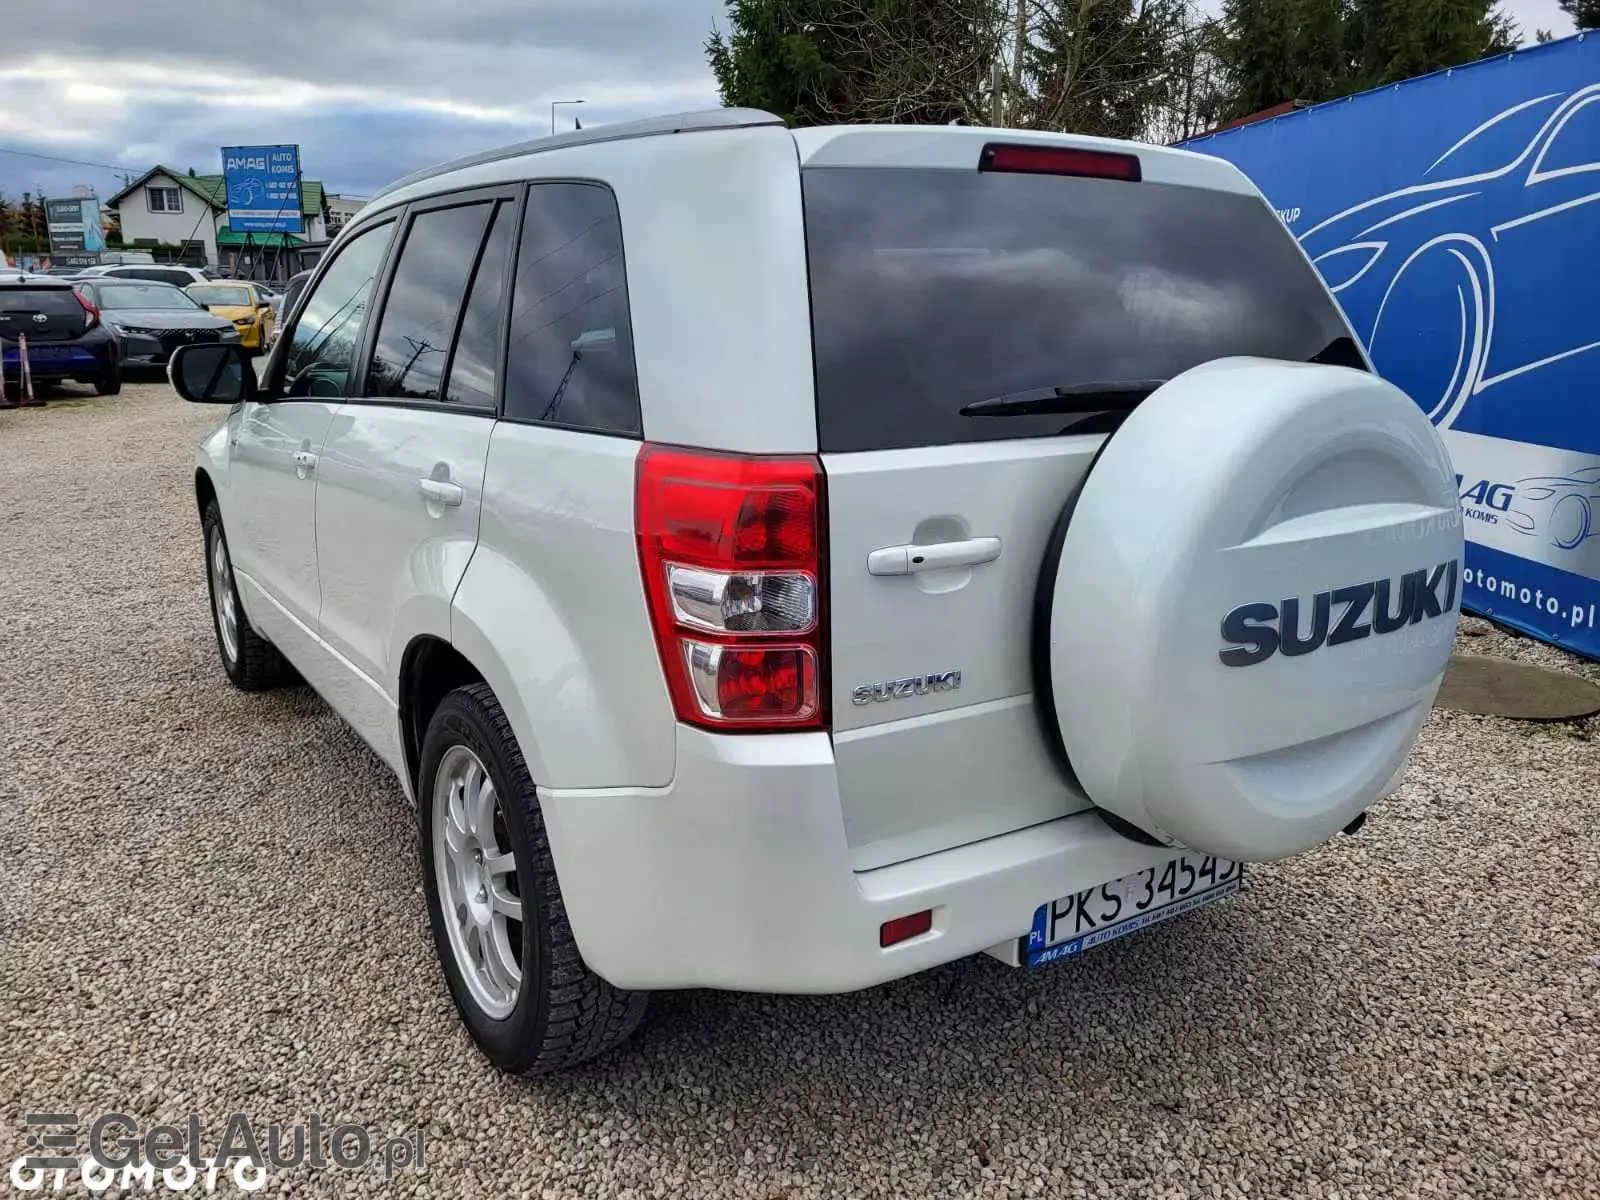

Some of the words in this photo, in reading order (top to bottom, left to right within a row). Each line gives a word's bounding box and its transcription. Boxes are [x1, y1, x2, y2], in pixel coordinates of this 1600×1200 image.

[227, 157, 265, 170] AMAG
[272, 152, 292, 162] AUTO
[1465, 508, 1499, 525] KOMIS
[1463, 567, 1596, 629] otomoto.pl
[1219, 560, 1458, 667] SUZUKI
[852, 670, 961, 706] SUZUKI
[1050, 877, 1123, 941] PKS
[1029, 930, 1043, 944] PL
